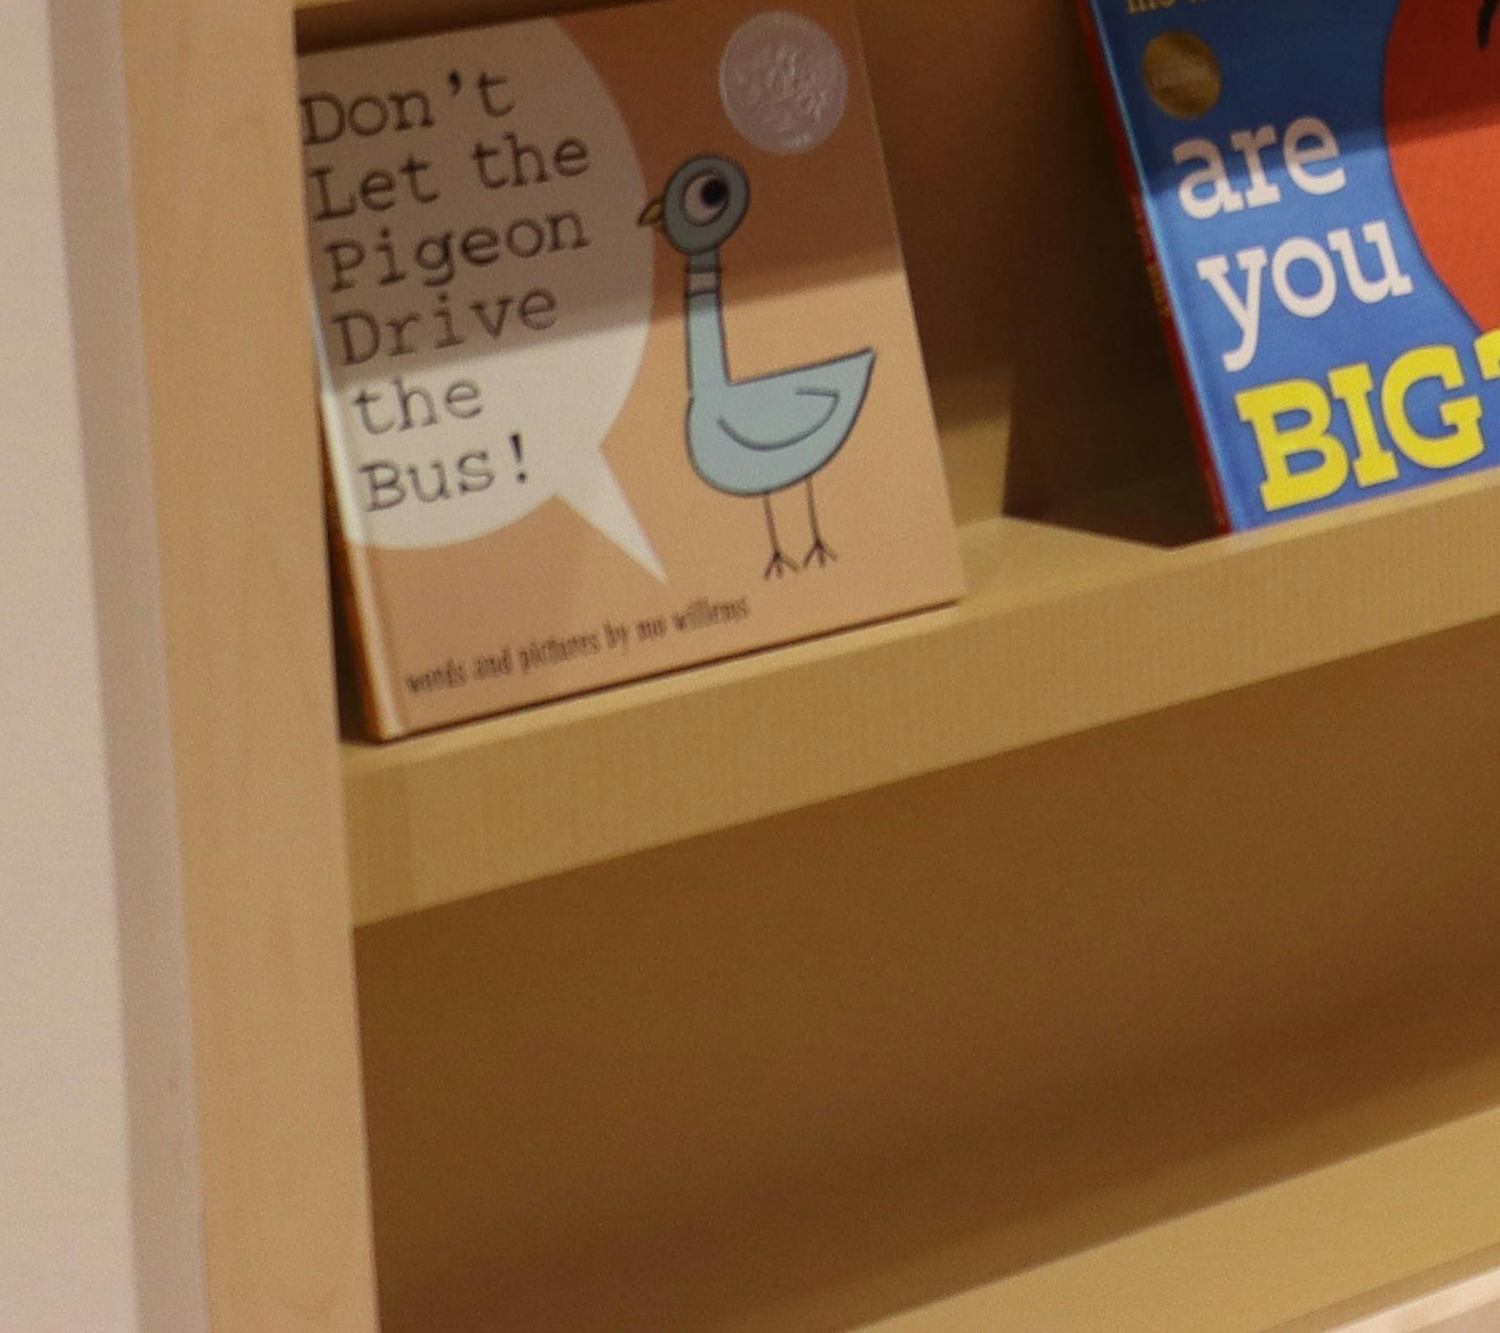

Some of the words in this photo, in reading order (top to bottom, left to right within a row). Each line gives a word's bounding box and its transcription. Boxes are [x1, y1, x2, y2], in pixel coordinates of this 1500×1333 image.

[299, 69, 517, 148] Don't
[309, 154, 442, 224] Let
[472, 130, 593, 191] the
[1170, 115, 1347, 221] are
[325, 206, 592, 294] Pigeon
[332, 283, 559, 369] Drive
[1195, 217, 1414, 375] you
[353, 375, 486, 438] the
[359, 433, 530, 515] Bus!
